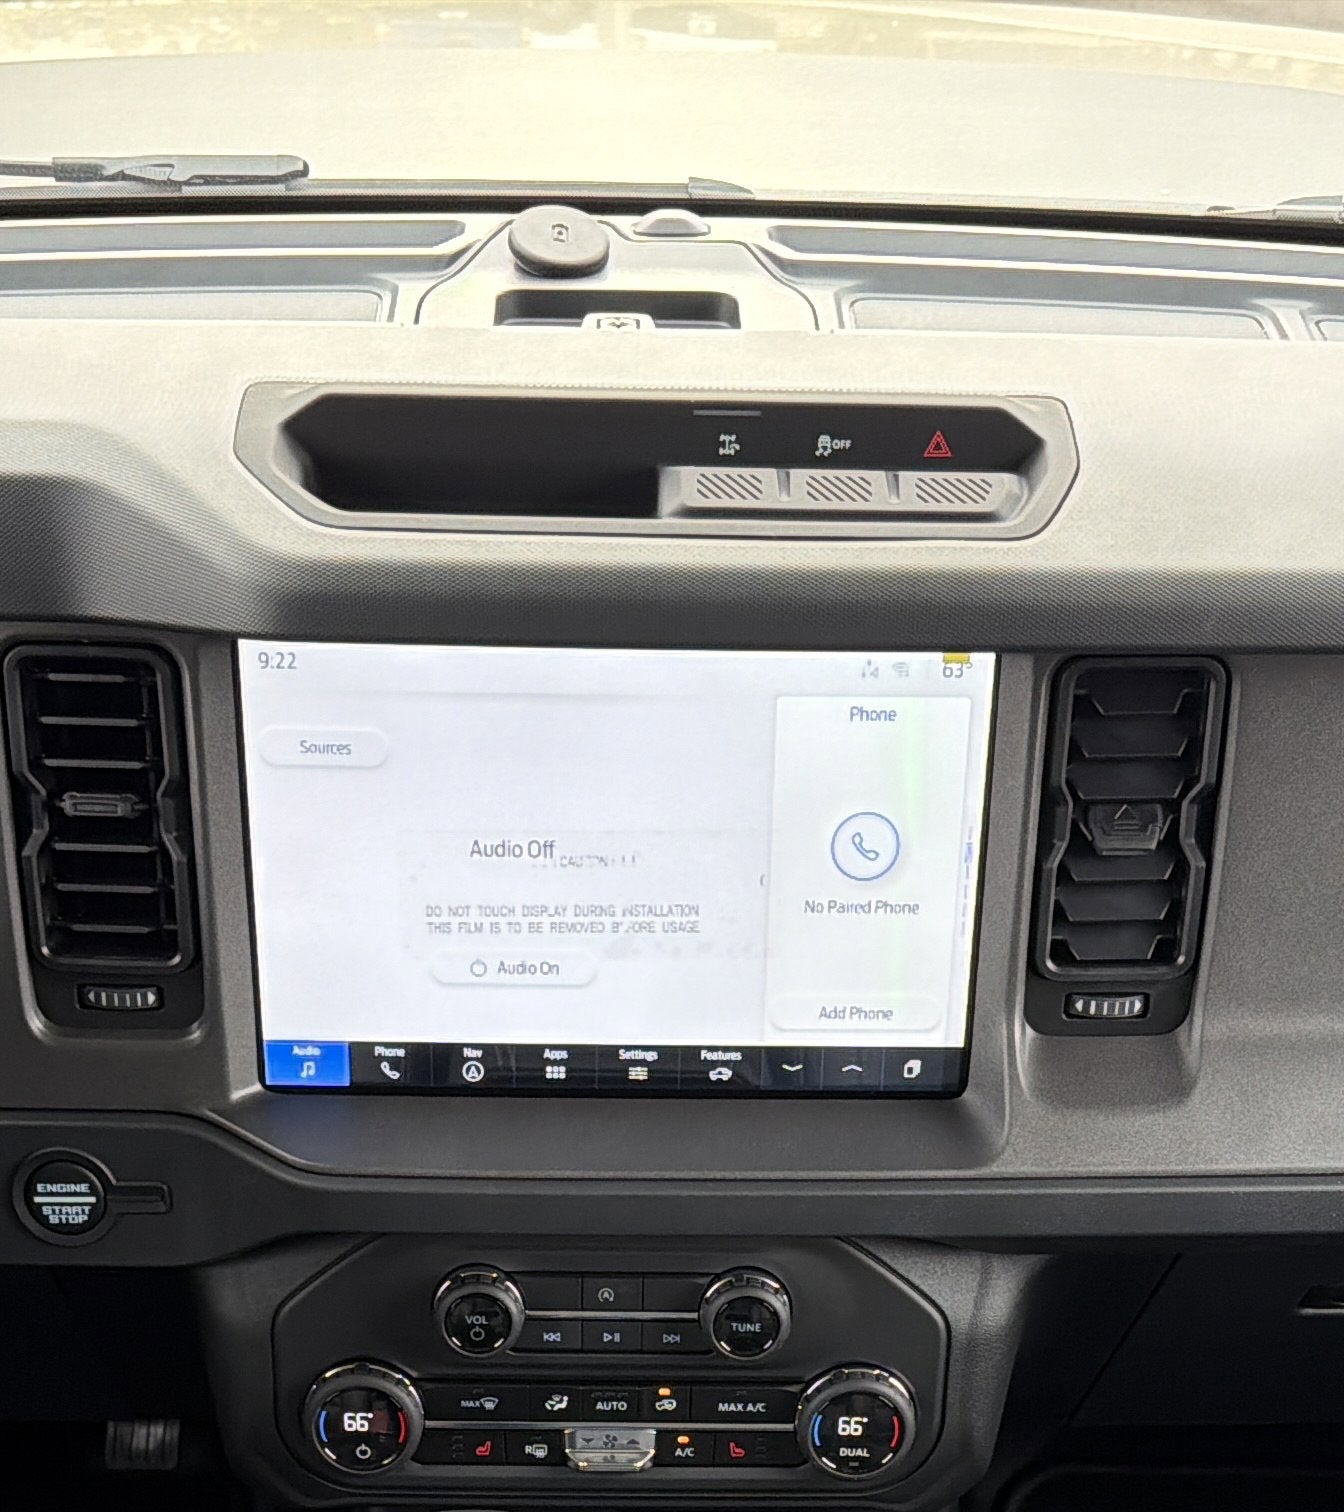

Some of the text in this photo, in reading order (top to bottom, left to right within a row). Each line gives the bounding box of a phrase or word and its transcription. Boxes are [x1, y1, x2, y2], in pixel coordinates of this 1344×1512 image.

[832, 439, 853, 450] OFF
[257, 651, 297, 670] 9:22
[849, 706, 898, 722] Phone
[299, 739, 352, 756] Sources
[469, 839, 556, 859] Audio Off
[425, 903, 700, 918] DO NOT TOUCH DISPLAY DURING INSTALLATION
[803, 900, 920, 915] No Paired Phone
[427, 921, 453, 934] THIS
[457, 921, 484, 934] FILM
[489, 921, 502, 934] IS
[507, 921, 522, 934] TO
[527, 921, 544, 934] BE
[550, 921, 606, 934] REMOVED
[662, 920, 701, 933] USAGE
[497, 960, 560, 976] Audio On
[818, 1006, 894, 1021] Add Phone
[292, 1045, 322, 1056] Audio
[374, 1046, 406, 1057] Phone
[463, 1047, 483, 1058] Nav
[543, 1049, 569, 1060] Apps
[618, 1049, 658, 1062] Settings
[700, 1050, 742, 1061] Features
[36, 1183, 90, 1193] ENGINE
[42, 1205, 92, 1215] START
[48, 1214, 89, 1224] STOP
[465, 1315, 489, 1326] VOL
[731, 1322, 763, 1334] TUNE
[460, 1400, 480, 1408] MAX
[595, 1401, 628, 1411] AUTO
[718, 1402, 767, 1413] MAX A/C
[674, 1447, 695, 1458] A/C
[839, 1447, 870, 1458] DUAL
